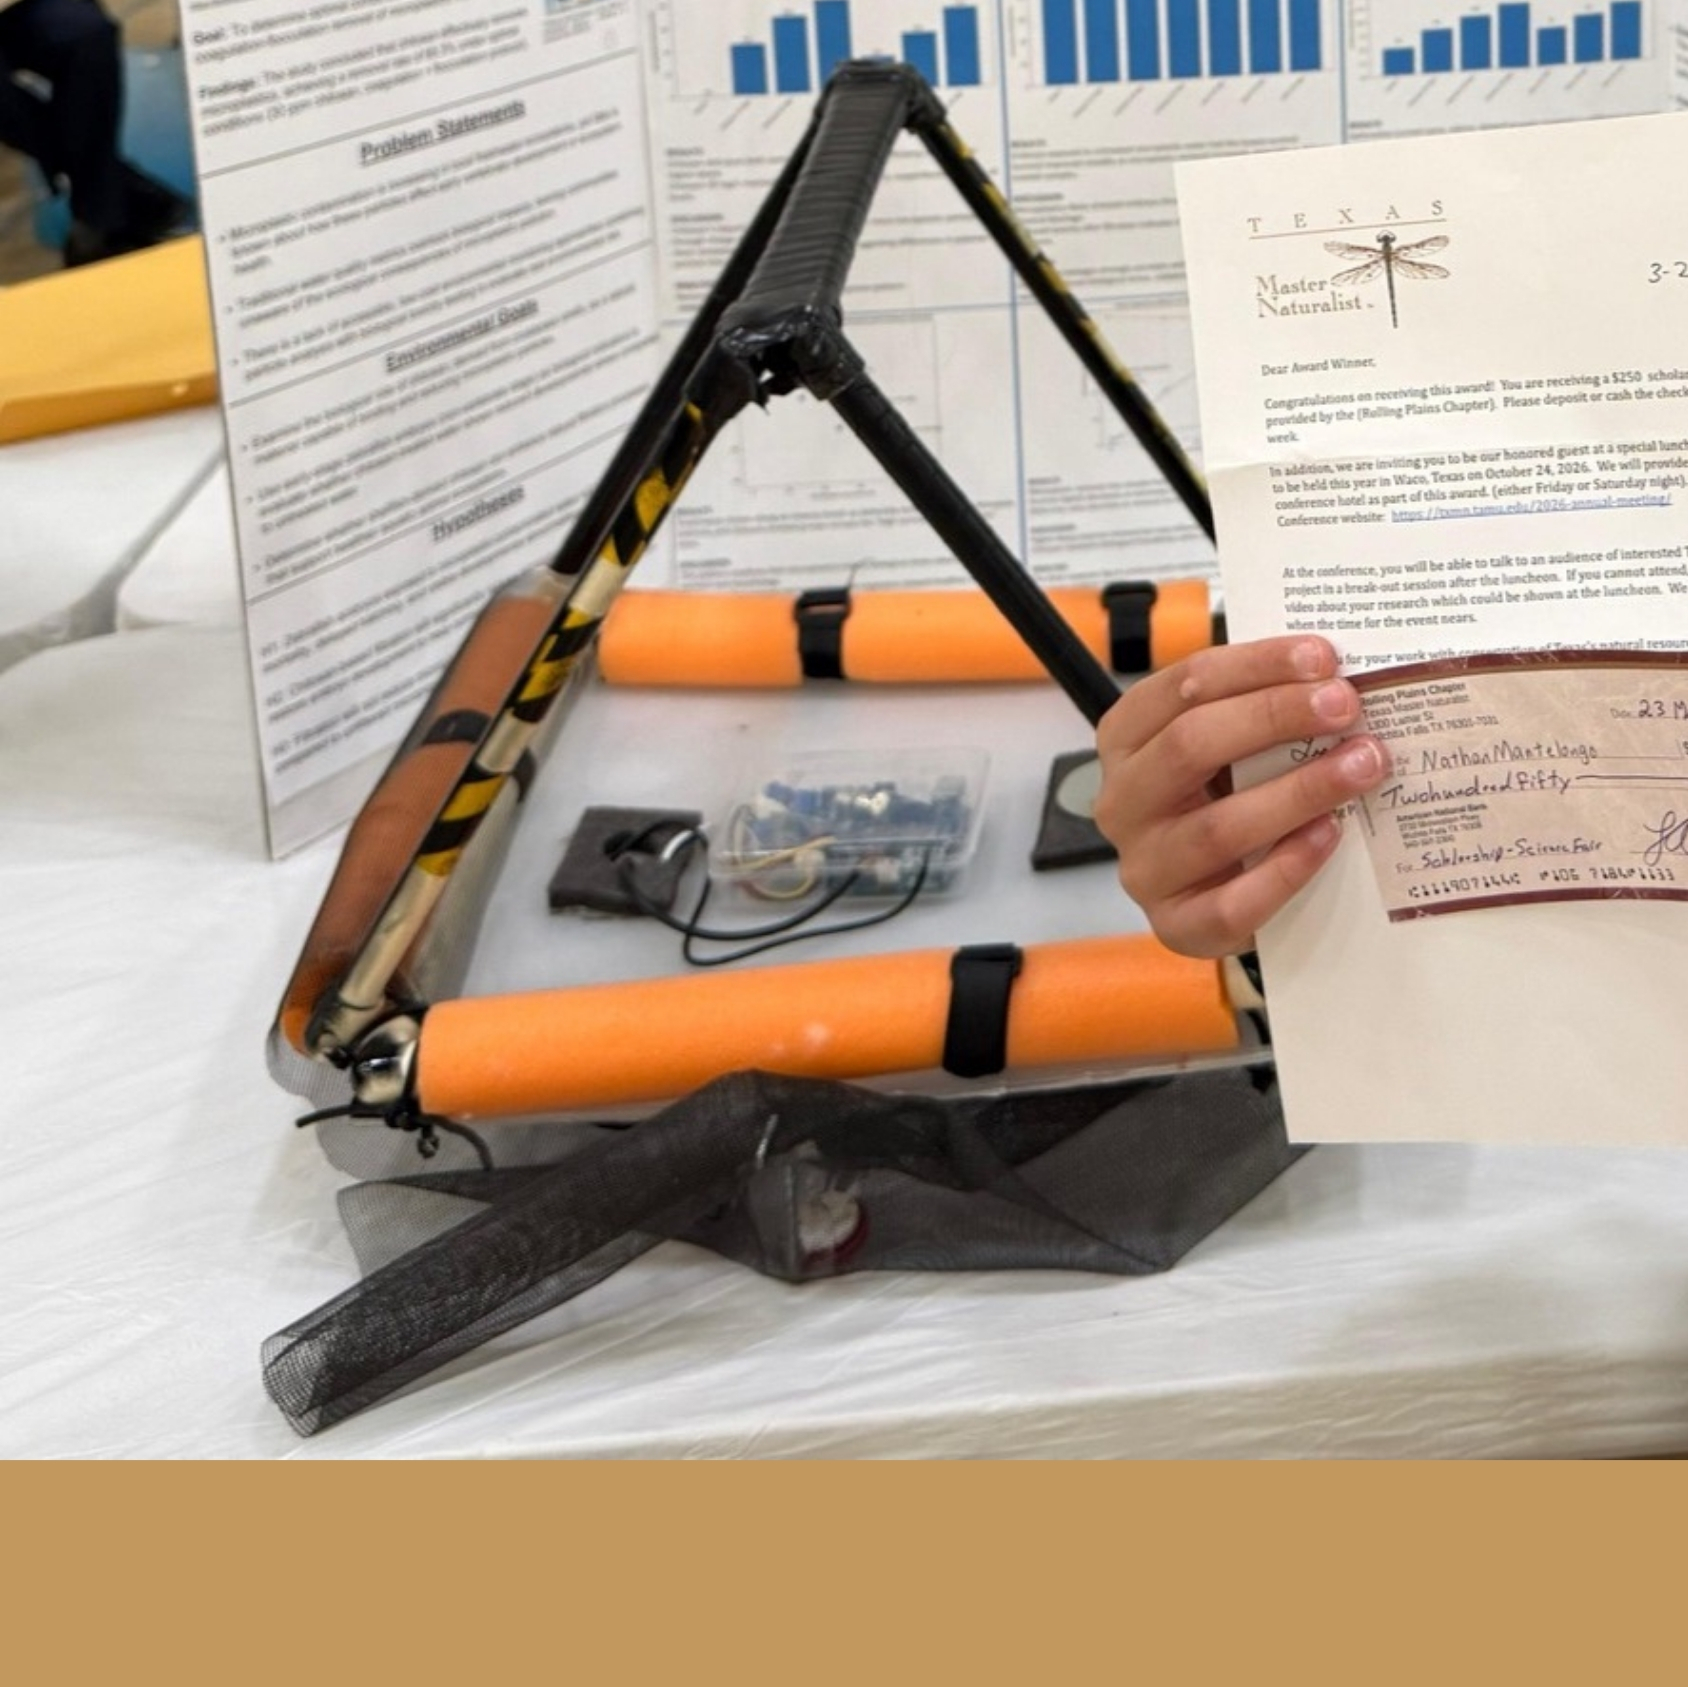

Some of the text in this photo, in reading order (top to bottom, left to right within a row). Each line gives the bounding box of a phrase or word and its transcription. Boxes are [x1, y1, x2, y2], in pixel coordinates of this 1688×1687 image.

[358, 127, 434, 167] Problem
[1256, 275, 1327, 297] Master
[1261, 364, 1288, 376] Dear
[1291, 360, 1329, 373] Award
[1264, 391, 1354, 410] Congratulations
[1357, 392, 1372, 402] on
[1375, 385, 1428, 400] receiving
[1430, 383, 1452, 396] this
[1501, 378, 1522, 391] You
[1524, 379, 1544, 389] are
[1546, 373, 1601, 388] receiving
[1612, 370, 1641, 384] $250
[1265, 413, 1316, 429] provided
[1319, 411, 1333, 425] by
[1335, 409, 1355, 422] the
[1405, 402, 1441, 416] Plains
[1503, 395, 1541, 408] Please
[1543, 392, 1588, 407] deposit
[1590, 392, 1603, 402] or
[1606, 389, 1632, 402] cash
[1634, 387, 1654, 400] the
[1267, 431, 1300, 444] week.
[1277, 513, 1338, 528] Conference
[1340, 511, 1386, 525] website:
[1397, 685, 1428, 700] Plains
[1428, 681, 1467, 696] Chapter
[1638, 699, 1665, 718] 23
